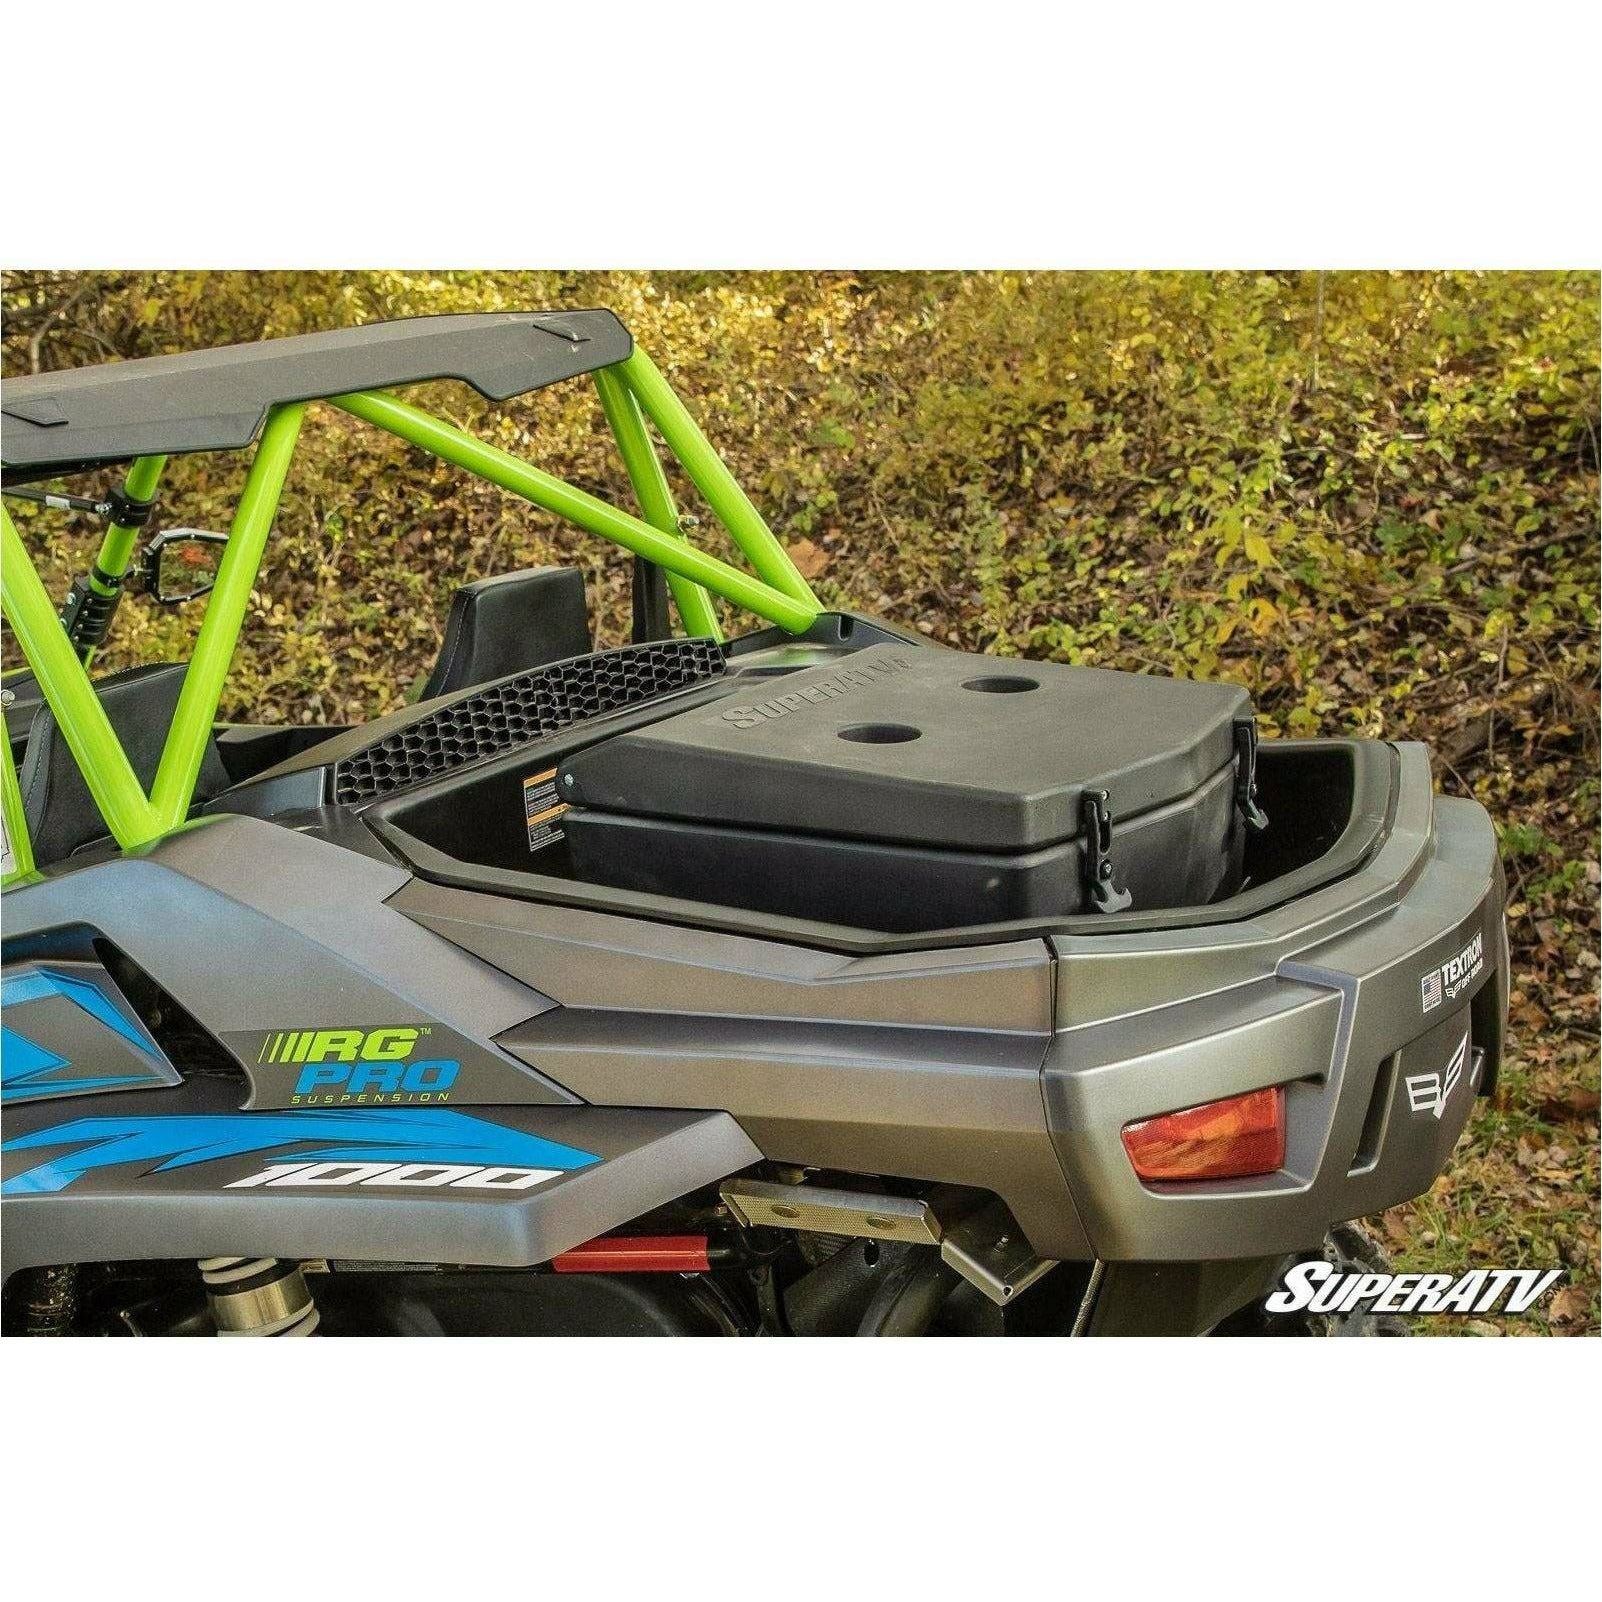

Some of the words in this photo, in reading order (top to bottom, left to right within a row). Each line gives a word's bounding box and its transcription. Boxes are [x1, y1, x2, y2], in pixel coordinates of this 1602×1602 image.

[1441, 932, 1482, 987] TEXTRON
[294, 1059, 461, 1094] PRO
[290, 1092, 450, 1104] SUSPENSION
[222, 1162, 566, 1190] 1000
